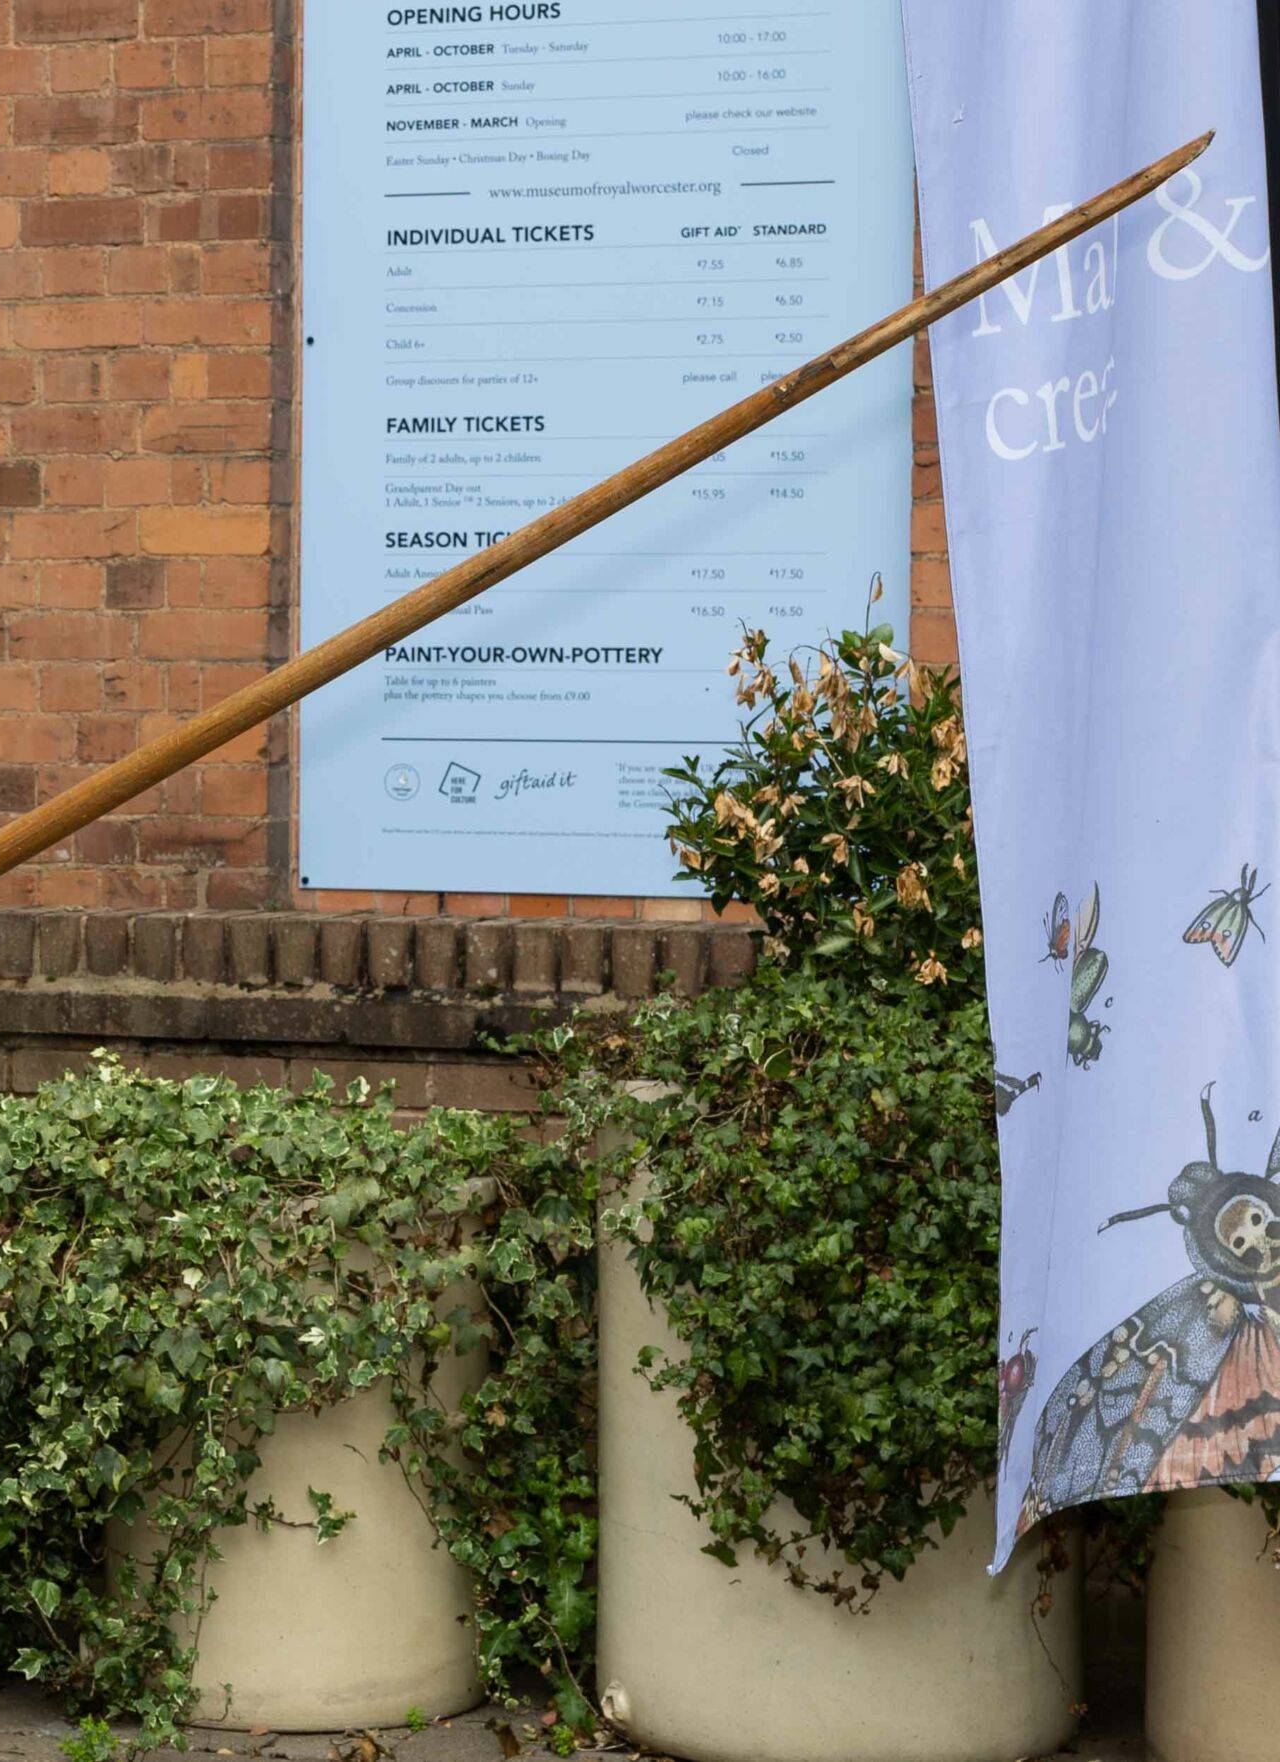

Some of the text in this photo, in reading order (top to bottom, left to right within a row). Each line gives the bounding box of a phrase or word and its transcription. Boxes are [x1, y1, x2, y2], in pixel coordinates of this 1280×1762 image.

[386, 2, 562, 26] OPENING HOURS
[718, 33, 747, 44] 10:00
[757, 31, 787, 42] 17:00
[386, 47, 422, 59] APRIL
[433, 44, 495, 56] OCTOBER
[502, 43, 539, 55] Tuesday
[548, 41, 589, 52] Saturday
[717, 70, 746, 81] 10:00
[757, 68, 787, 79] 16:00
[386, 84, 422, 95] APRIL
[433, 81, 495, 93] OCTOBER
[501, 80, 536, 92] Sunday
[685, 105, 818, 123] please check our website
[386, 119, 460, 132] NOVEMBER
[470, 116, 519, 129] MARCH
[525, 117, 568, 130] Opening
[386, 156, 415, 167] Easter
[416, 155, 451, 167] Sunday
[458, 152, 506, 164] Christmas
[508, 150, 528, 164] Day
[536, 150, 570, 163] Boxing
[572, 148, 591, 162] Day
[732, 144, 770, 156] Closed
[489, 179, 722, 199] www.museumofroyalworcester.org
[680, 226, 710, 238] GIFT
[753, 223, 827, 237] STANDARD
[1146, 167, 1271, 281] &
[386, 224, 595, 246] INDIVIDUAL TICKETS
[386, 266, 412, 277] Adult
[386, 302, 438, 313] Concession
[386, 338, 412, 349] Child
[386, 376, 417, 388] Group
[417, 374, 461, 386] discounts
[461, 373, 477, 385] for
[477, 374, 509, 388] parties
[509, 373, 522, 384] of
[682, 372, 717, 385] please
[719, 371, 738, 382] call
[386, 415, 546, 434] FAMILY TICKETS
[385, 453, 417, 466] Family
[418, 452, 429, 464] of
[429, 453, 437, 463] 2
[469, 456, 480, 467] up
[483, 454, 494, 463] to
[495, 453, 502, 463] 2
[503, 451, 542, 463] children
[385, 483, 482, 495] Grandparent Day out
[431, 496, 462, 507] Senior
[476, 497, 483, 507] 2
[523, 499, 535, 510] up
[535, 497, 547, 508] to
[548, 496, 556, 506] 2
[385, 531, 468, 549] SEASON
[384, 568, 411, 580] Adult
[473, 605, 494, 616] Pass
[384, 647, 664, 664] PAINT-YOUR-OWN-POTTERY
[384, 675, 414, 687] Table
[415, 675, 426, 686] for
[426, 678, 438, 689] up
[440, 677, 451, 687] to
[460, 677, 497, 689] painters
[383, 690, 591, 704] plus the pottery shapes you choose from £9.00
